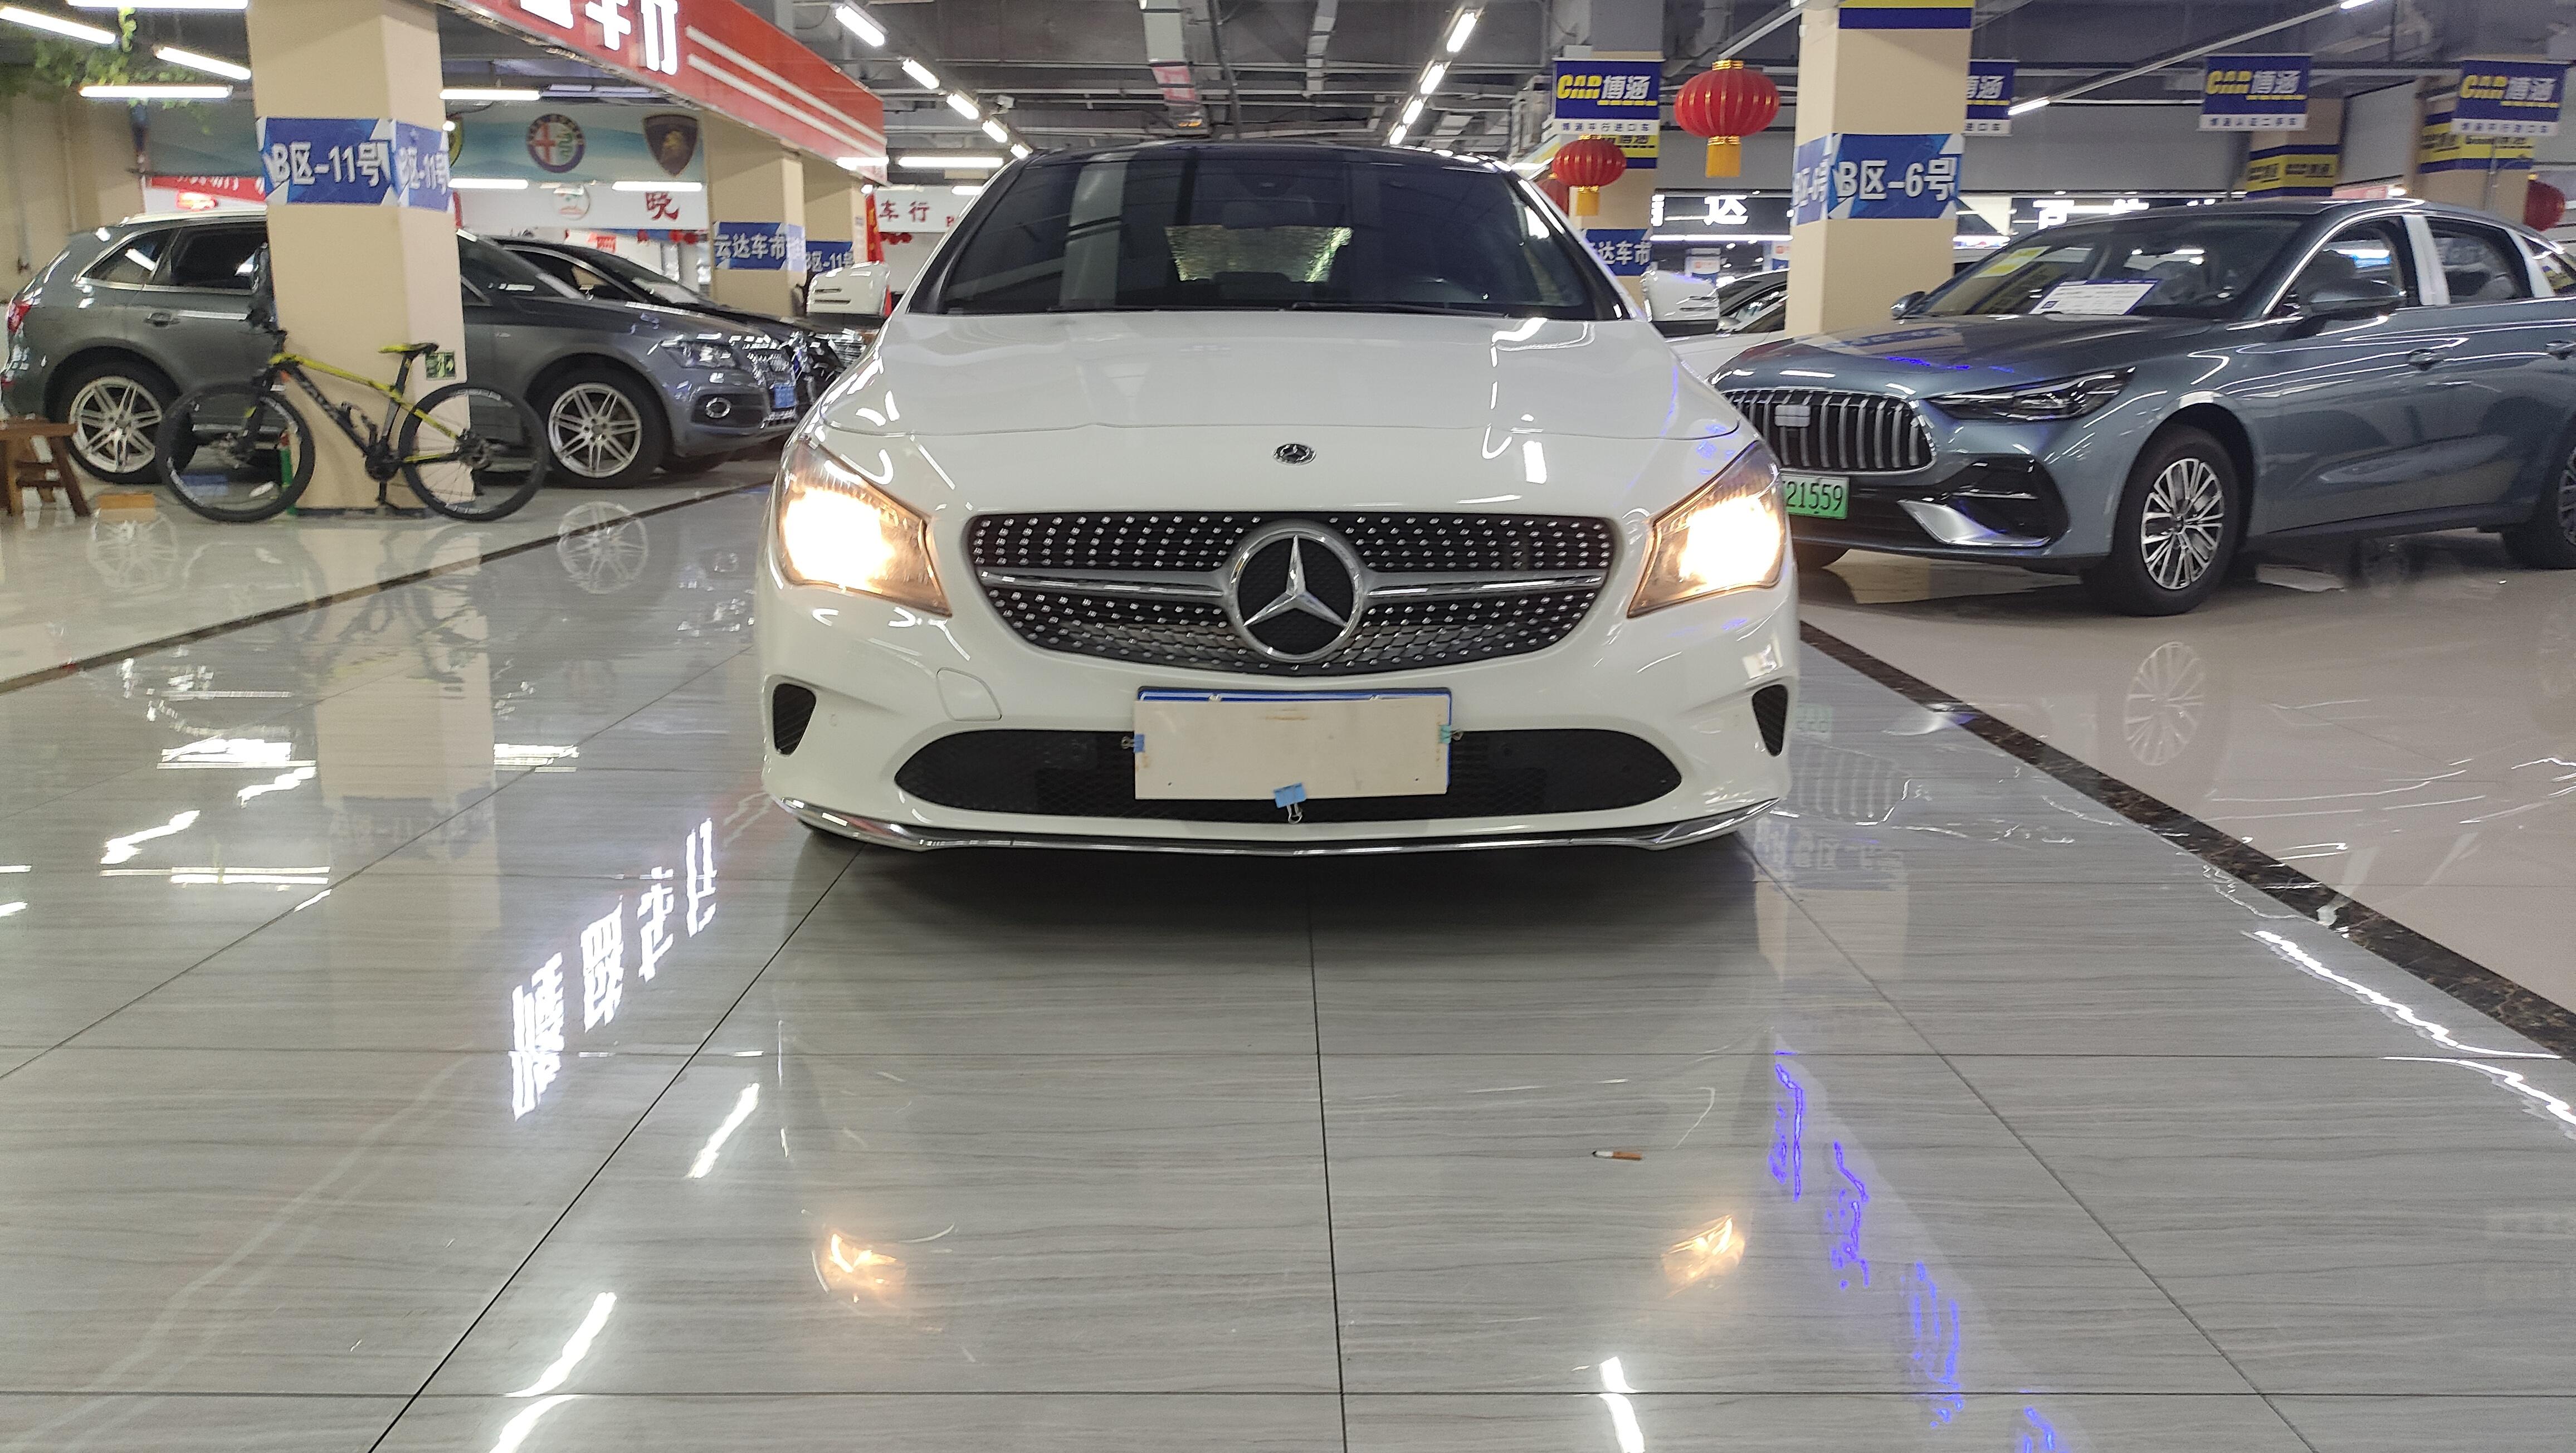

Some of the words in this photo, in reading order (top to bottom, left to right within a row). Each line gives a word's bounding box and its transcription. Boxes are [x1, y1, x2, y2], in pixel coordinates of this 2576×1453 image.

[266, 141, 384, 188] B区-11号
[1836, 158, 1957, 202] B区-6号
[879, 198, 930, 222] 车行
[714, 232, 787, 260] 云达车市
[1589, 240, 1652, 266] 达车市
[1782, 480, 1843, 511] 21559
